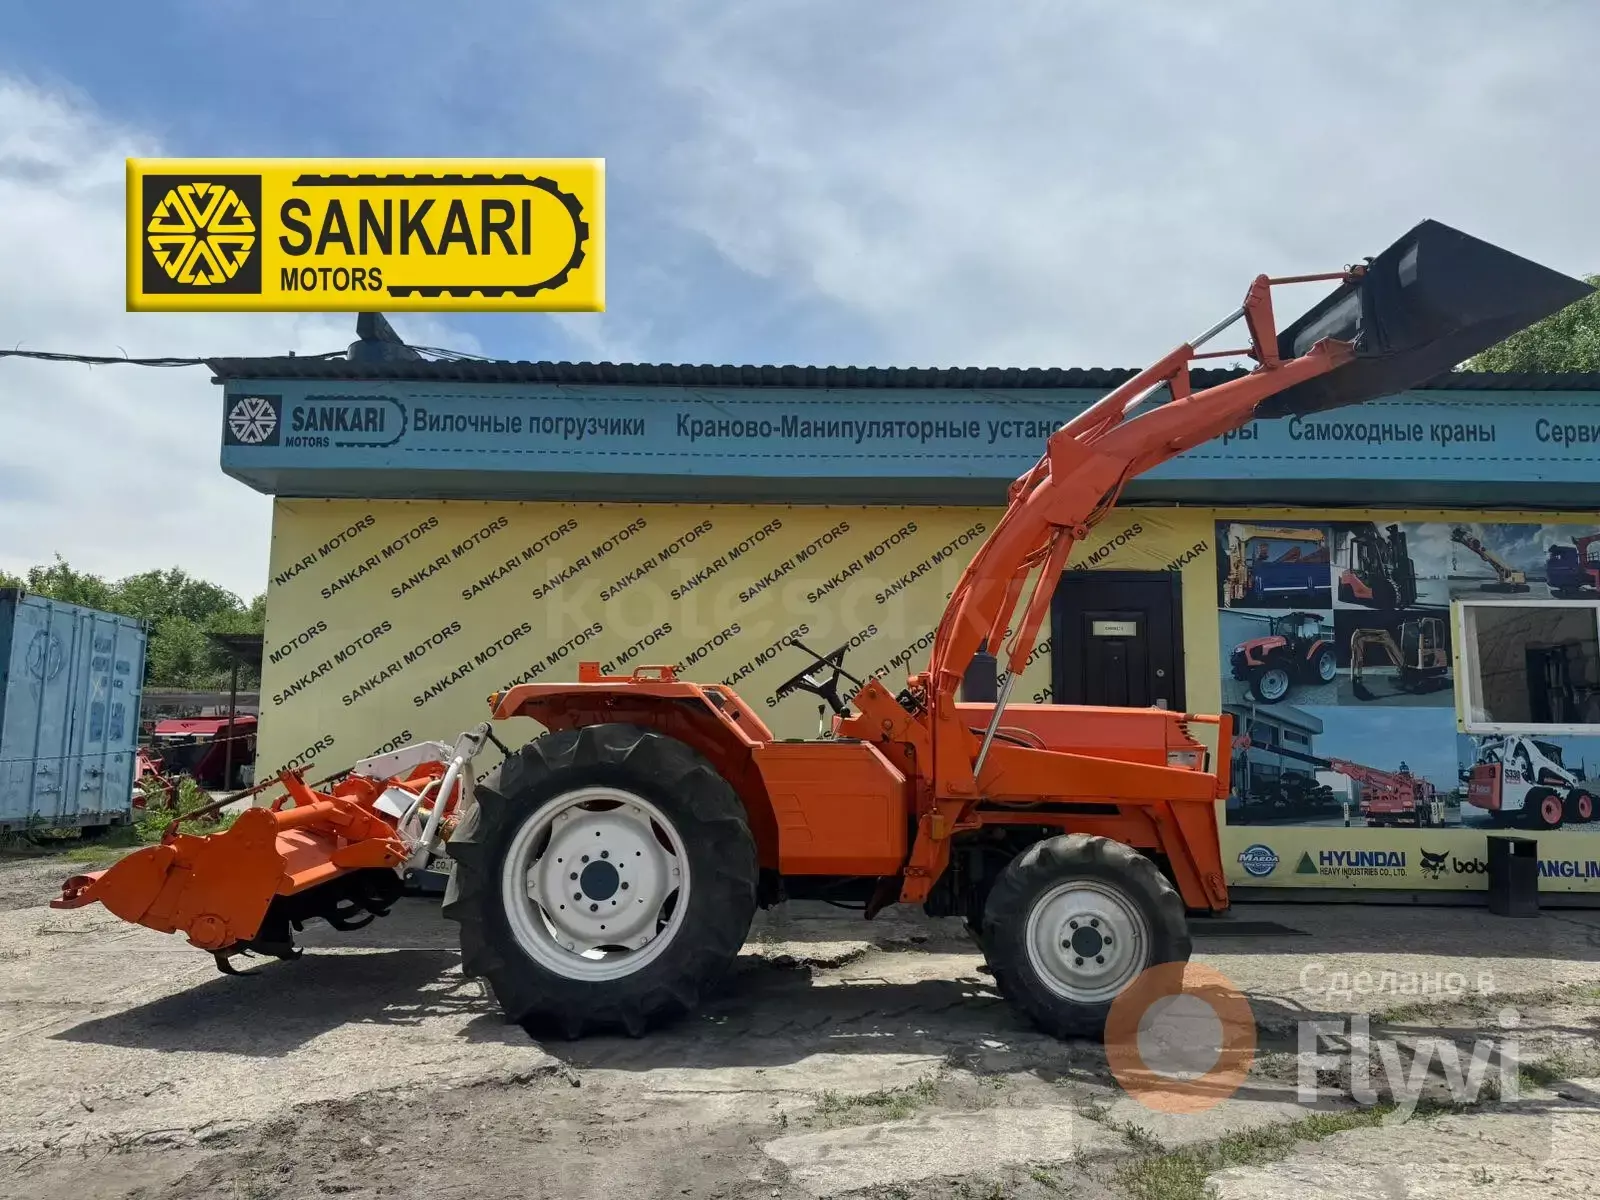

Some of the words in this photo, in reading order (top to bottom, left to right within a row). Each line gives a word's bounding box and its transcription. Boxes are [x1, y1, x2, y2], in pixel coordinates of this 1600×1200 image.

[291, 406, 385, 433] SANKARI
[413, 409, 522, 434] Вилочные
[528, 413, 645, 441] погрузчики
[676, 412, 980, 445] Краново-Манипуляторные
[1288, 416, 1423, 446] Самоходные
[1430, 422, 1496, 448] краны
[284, 436, 330, 448] MOTORS
[318, 514, 376, 558] MOTORS
[320, 554, 382, 600] SANKARI
[381, 516, 439, 559] MOTORS
[391, 553, 452, 599] SANKARI
[451, 515, 509, 559] MOTORS
[1088, 522, 1143, 566] MOTORS
[461, 555, 522, 601] SANKARI
[523, 518, 579, 561] MOTORS
[532, 554, 591, 601] SANKARI
[591, 517, 648, 560] MOTORS
[599, 556, 658, 602] SANKARI
[658, 519, 714, 562] MOTORS
[670, 555, 728, 601] SANKARI
[728, 518, 783, 561] MOTORS
[739, 557, 796, 603] SANKARI
[796, 520, 851, 563] MOTORS
[807, 558, 864, 604] SANKARI
[864, 521, 919, 564] MOTORS
[875, 559, 931, 605] SANKARI
[932, 522, 986, 565] MOTORS
[268, 620, 328, 665] MOTORS
[272, 660, 334, 706] SANKARI
[333, 620, 392, 665] MOTORS
[342, 660, 403, 706] SANKARI
[403, 621, 462, 665] MOTORS
[413, 661, 474, 707] SANKARI
[474, 622, 532, 666] MOTORS
[546, 622, 603, 666] MOTORS
[616, 622, 673, 666] MOTORS
[686, 623, 742, 666] MOTORS
[755, 623, 810, 667] MOTORS
[890, 627, 938, 669] MOTOR
[1319, 850, 1406, 867] HYUNDAI
[1319, 867, 1341, 875] HEAVY
[1341, 867, 1379, 876] INDUSTRIES
[1452, 857, 1488, 874] bob
